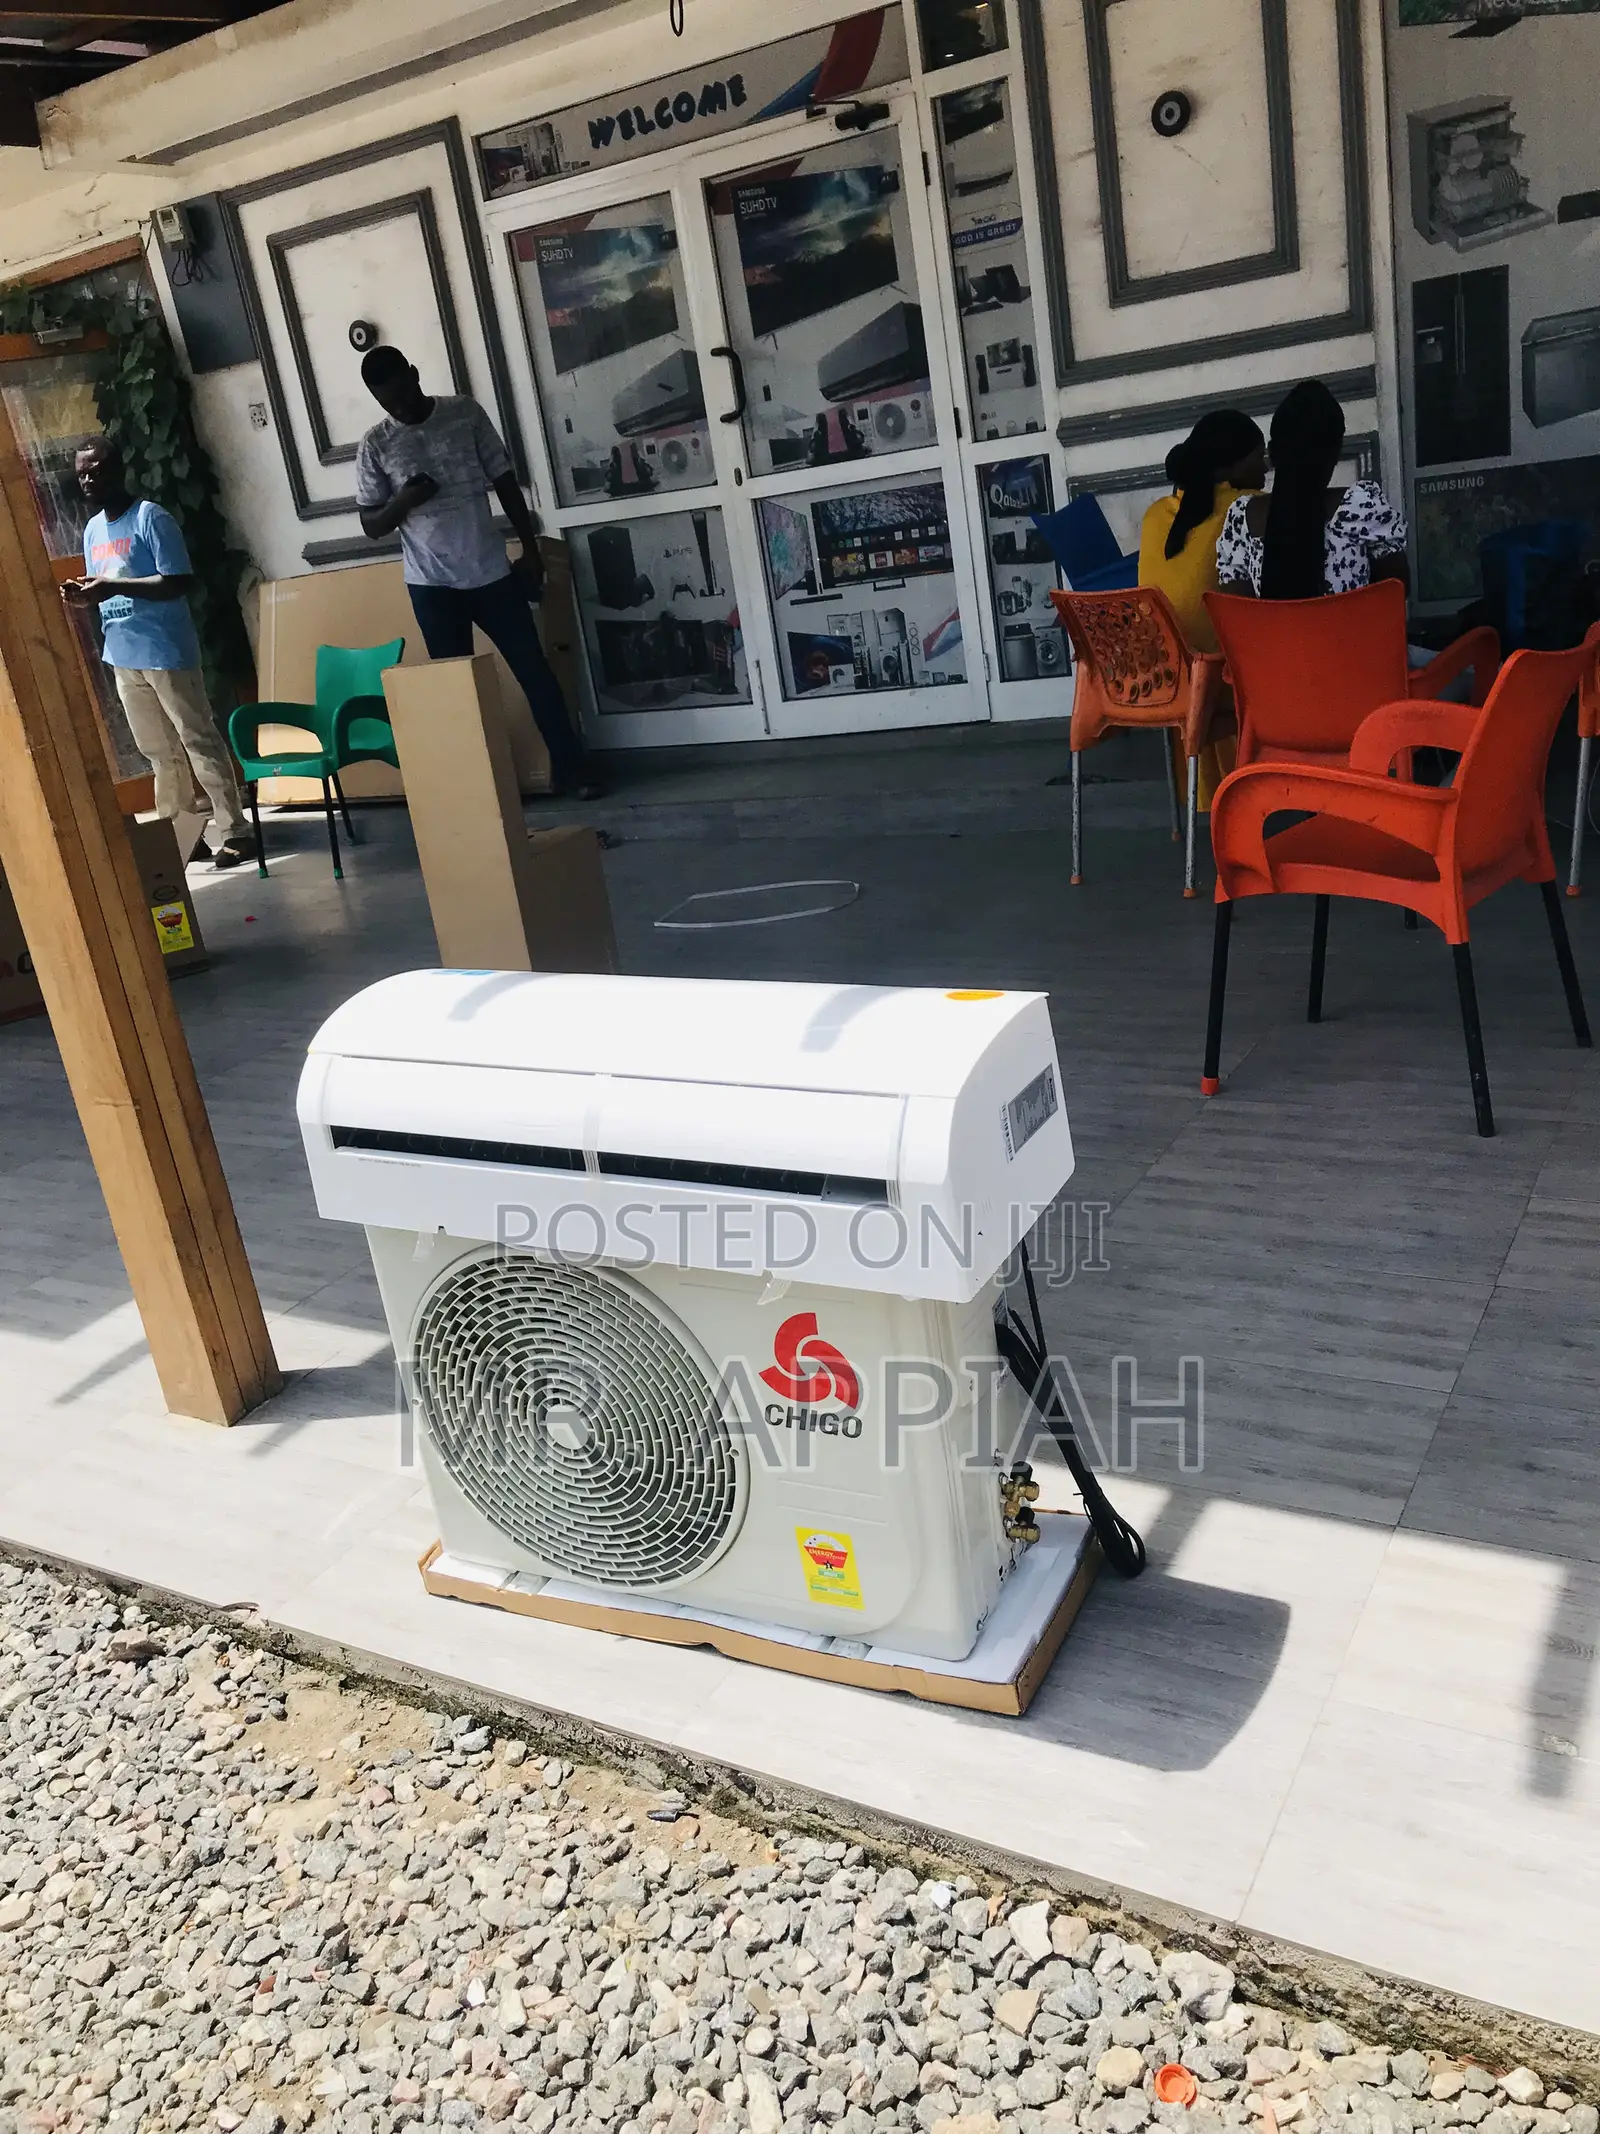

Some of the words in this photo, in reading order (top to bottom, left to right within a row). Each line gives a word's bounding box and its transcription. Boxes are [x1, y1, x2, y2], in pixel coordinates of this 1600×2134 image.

[587, 73, 748, 149] WELCOME
[1420, 476, 1485, 494] SAMSUNG
[764, 1404, 863, 1438] CHIGO
